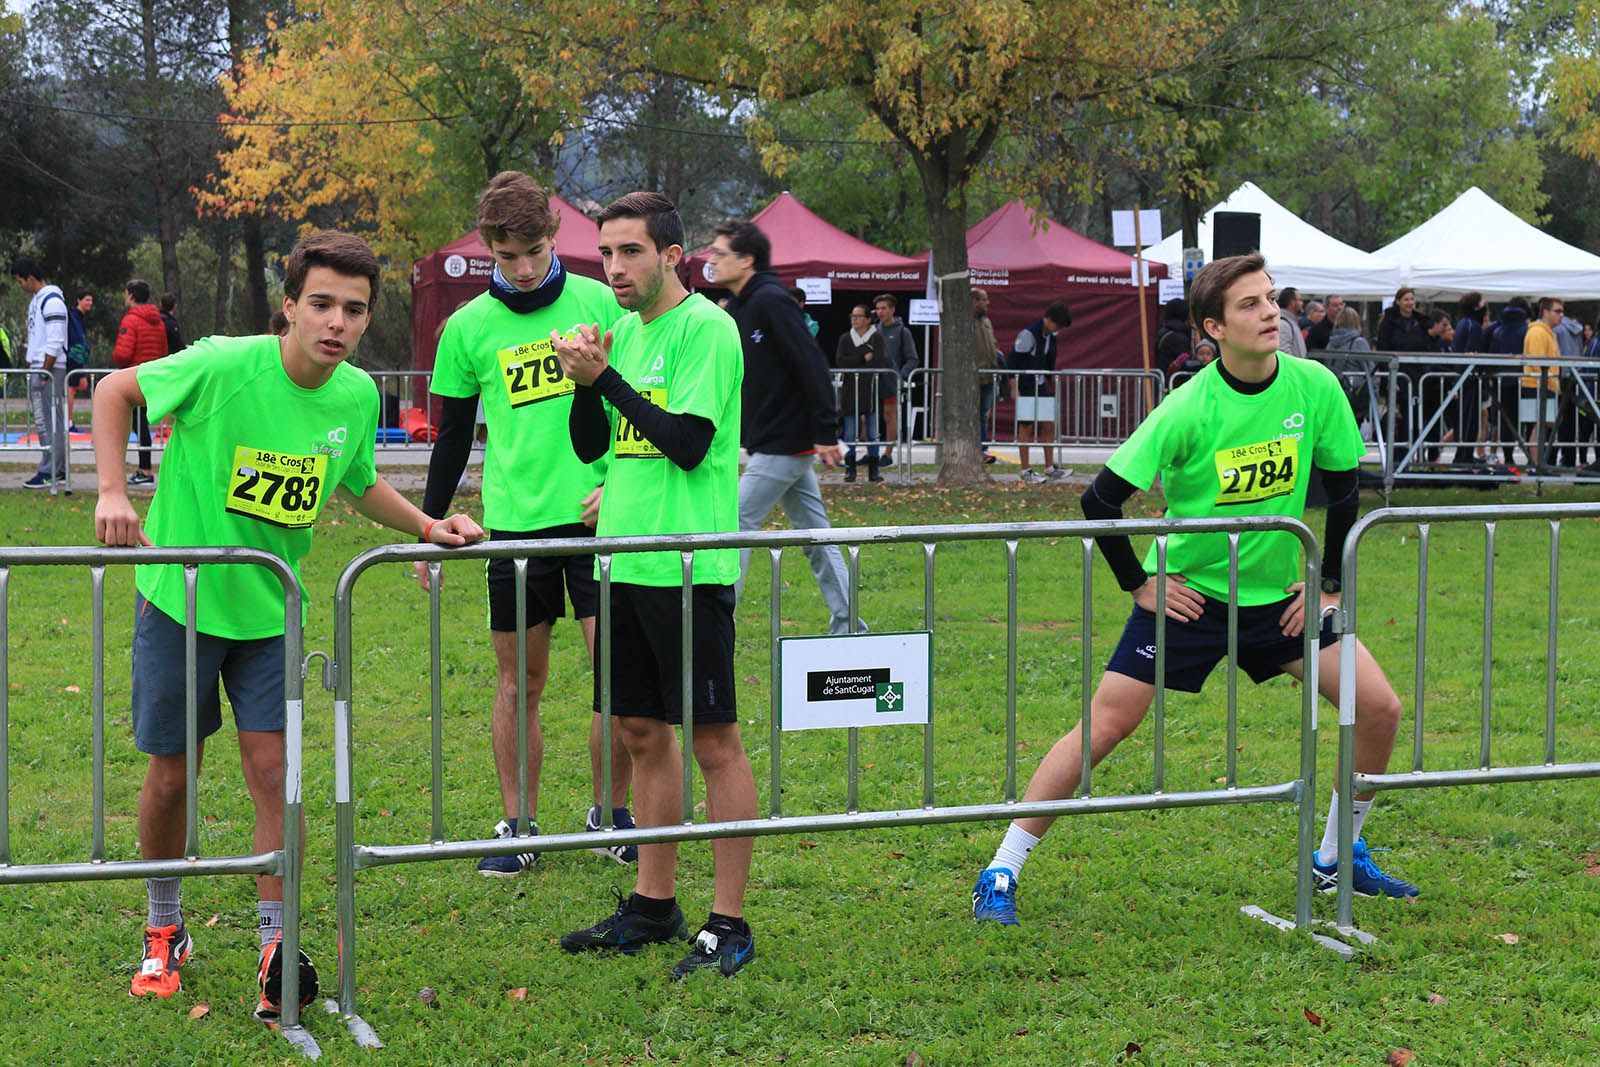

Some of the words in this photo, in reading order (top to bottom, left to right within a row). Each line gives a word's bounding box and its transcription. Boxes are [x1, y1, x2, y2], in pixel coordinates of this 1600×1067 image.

[470, 259, 492, 268] Dipu
[827, 271, 835, 279] al
[860, 271, 871, 279] de
[872, 271, 900, 280] l'esport
[902, 271, 920, 280] local
[970, 277, 1009, 285] Barcelona
[1076, 275, 1099, 283] servei
[1100, 275, 1109, 284] de
[1110, 276, 1132, 285] l'espo
[531, 342, 550, 352] Cros
[506, 354, 564, 394] 279
[1249, 445, 1267, 456] Cros
[256, 451, 276, 464] 18è
[280, 455, 301, 467] Cros
[1223, 456, 1294, 495] 2784
[232, 466, 320, 512] 2783
[825, 675, 872, 686] Ajuntament
[822, 686, 834, 695] de
[834, 684, 875, 695] SantCugat
